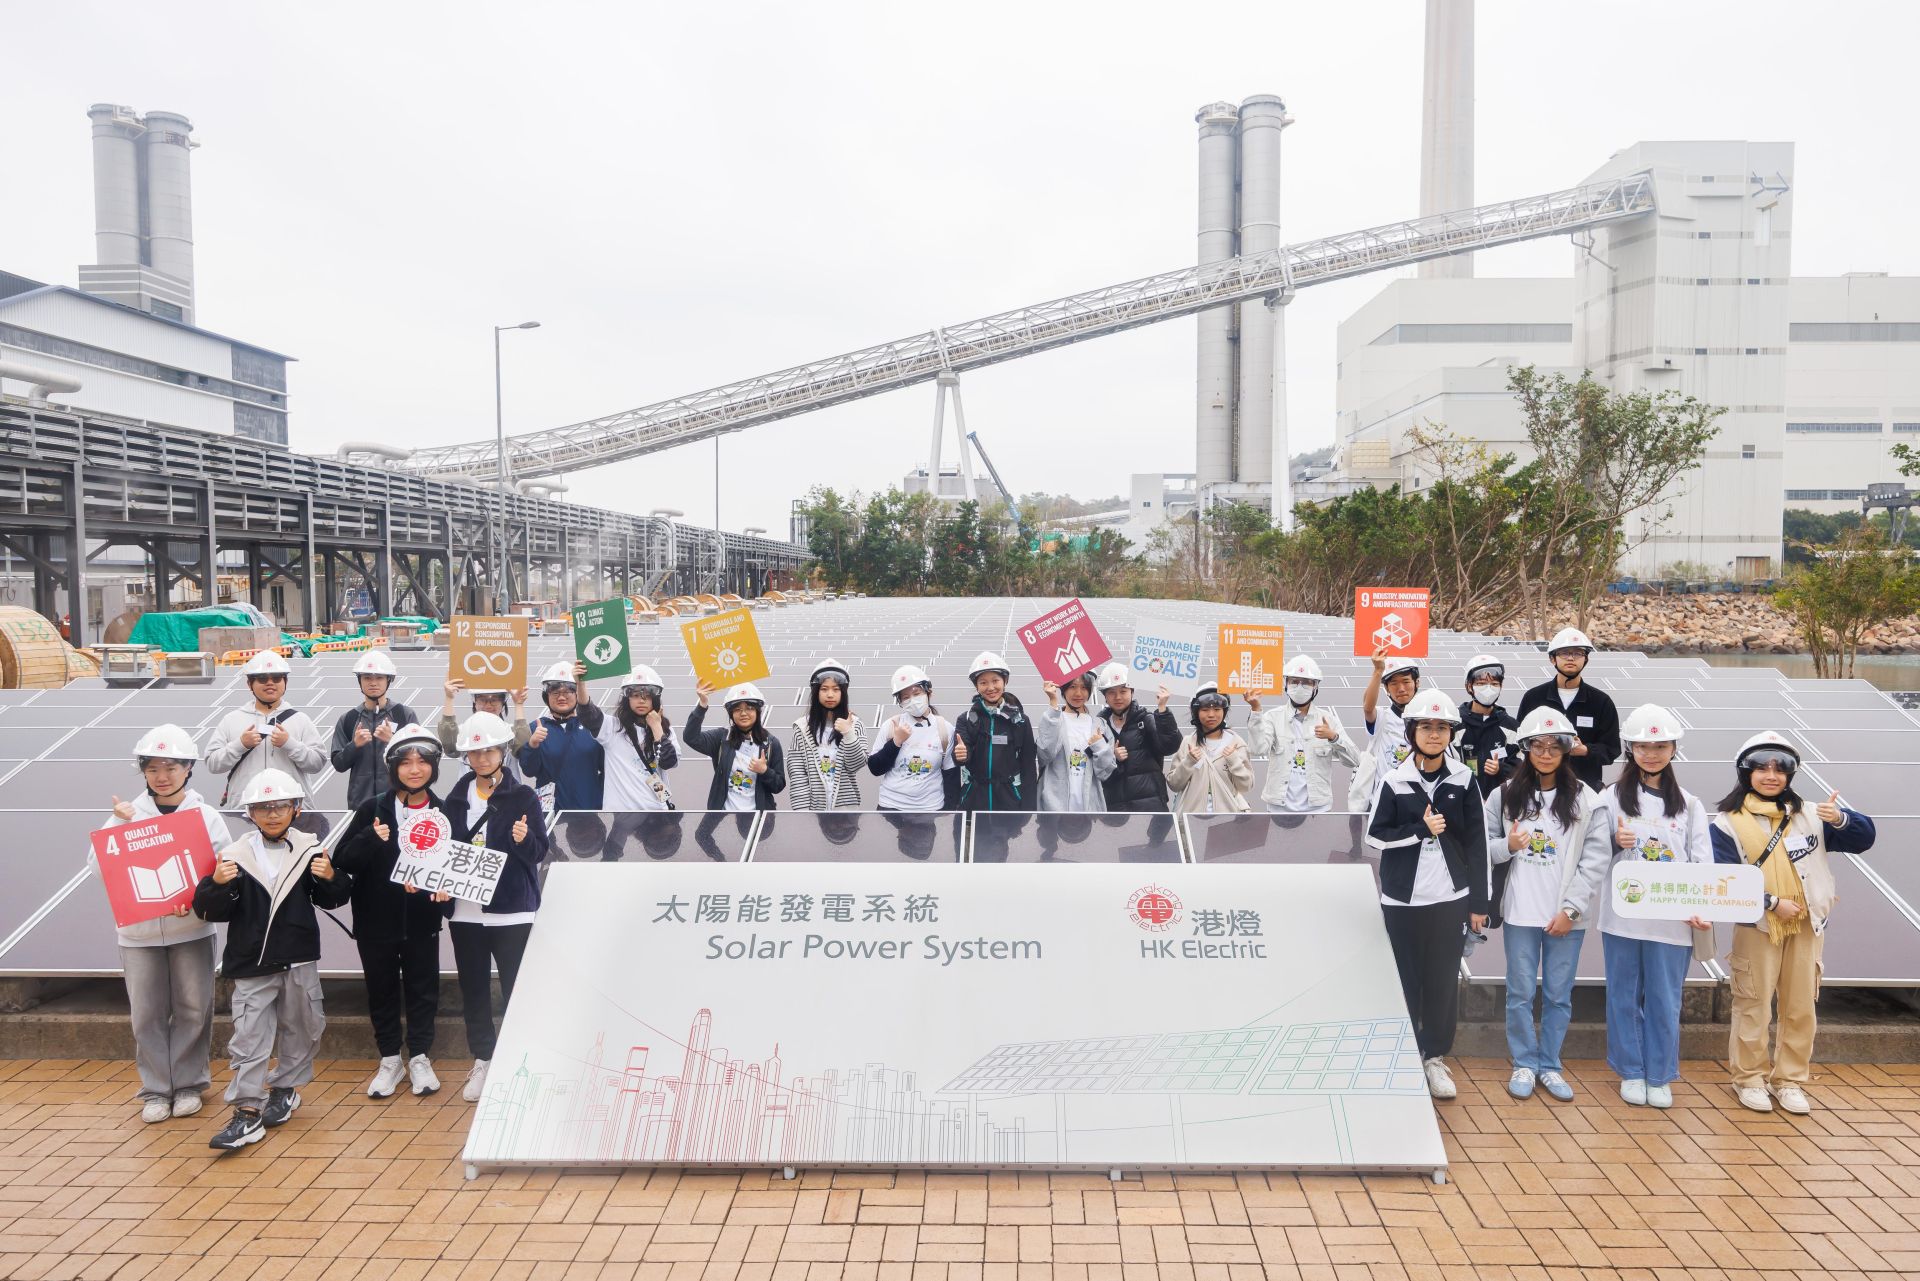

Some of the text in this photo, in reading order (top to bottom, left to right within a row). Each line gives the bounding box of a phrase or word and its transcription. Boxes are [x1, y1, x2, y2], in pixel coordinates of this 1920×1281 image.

[1361, 592, 1370, 608] 9
[1372, 600, 1427, 609] AND INFRASTRUCTURE
[474, 621, 512, 630] RESPONSIBLE
[575, 611, 587, 629] 13
[588, 616, 604, 626] ACTION
[733, 614, 745, 623] AND
[1034, 604, 1079, 633] DECENT WORK AND
[1038, 610, 1086, 640] ECONOMIC GROWTH
[456, 620, 470, 638] 12
[474, 630, 515, 639] CONSUMPTION
[688, 627, 697, 644] 7
[704, 624, 741, 640] CLEAN ENERGY
[1024, 629, 1037, 645] 8
[1223, 628, 1234, 645] 11
[474, 639, 522, 648] AND PRODUCTION
[1136, 635, 1201, 654] SUSTAINABLE
[1134, 645, 1200, 662] DEVELOPMENT
[1133, 654, 1198, 679] GOALS
[124, 824, 160, 841] QUALITY
[106, 834, 120, 856] 4
[127, 832, 175, 852] EDUCATION
[442, 843, 503, 881] 港燈
[392, 862, 492, 903] HK Electric
[651, 892, 940, 924] 太陽能發電系統
[1650, 896, 1678, 904] HAPPY
[1711, 898, 1758, 907] CAMPAIGN
[1190, 908, 1264, 937] 港燈
[705, 933, 1043, 967] Solar Power System
[1140, 939, 1268, 959] HK Electric
